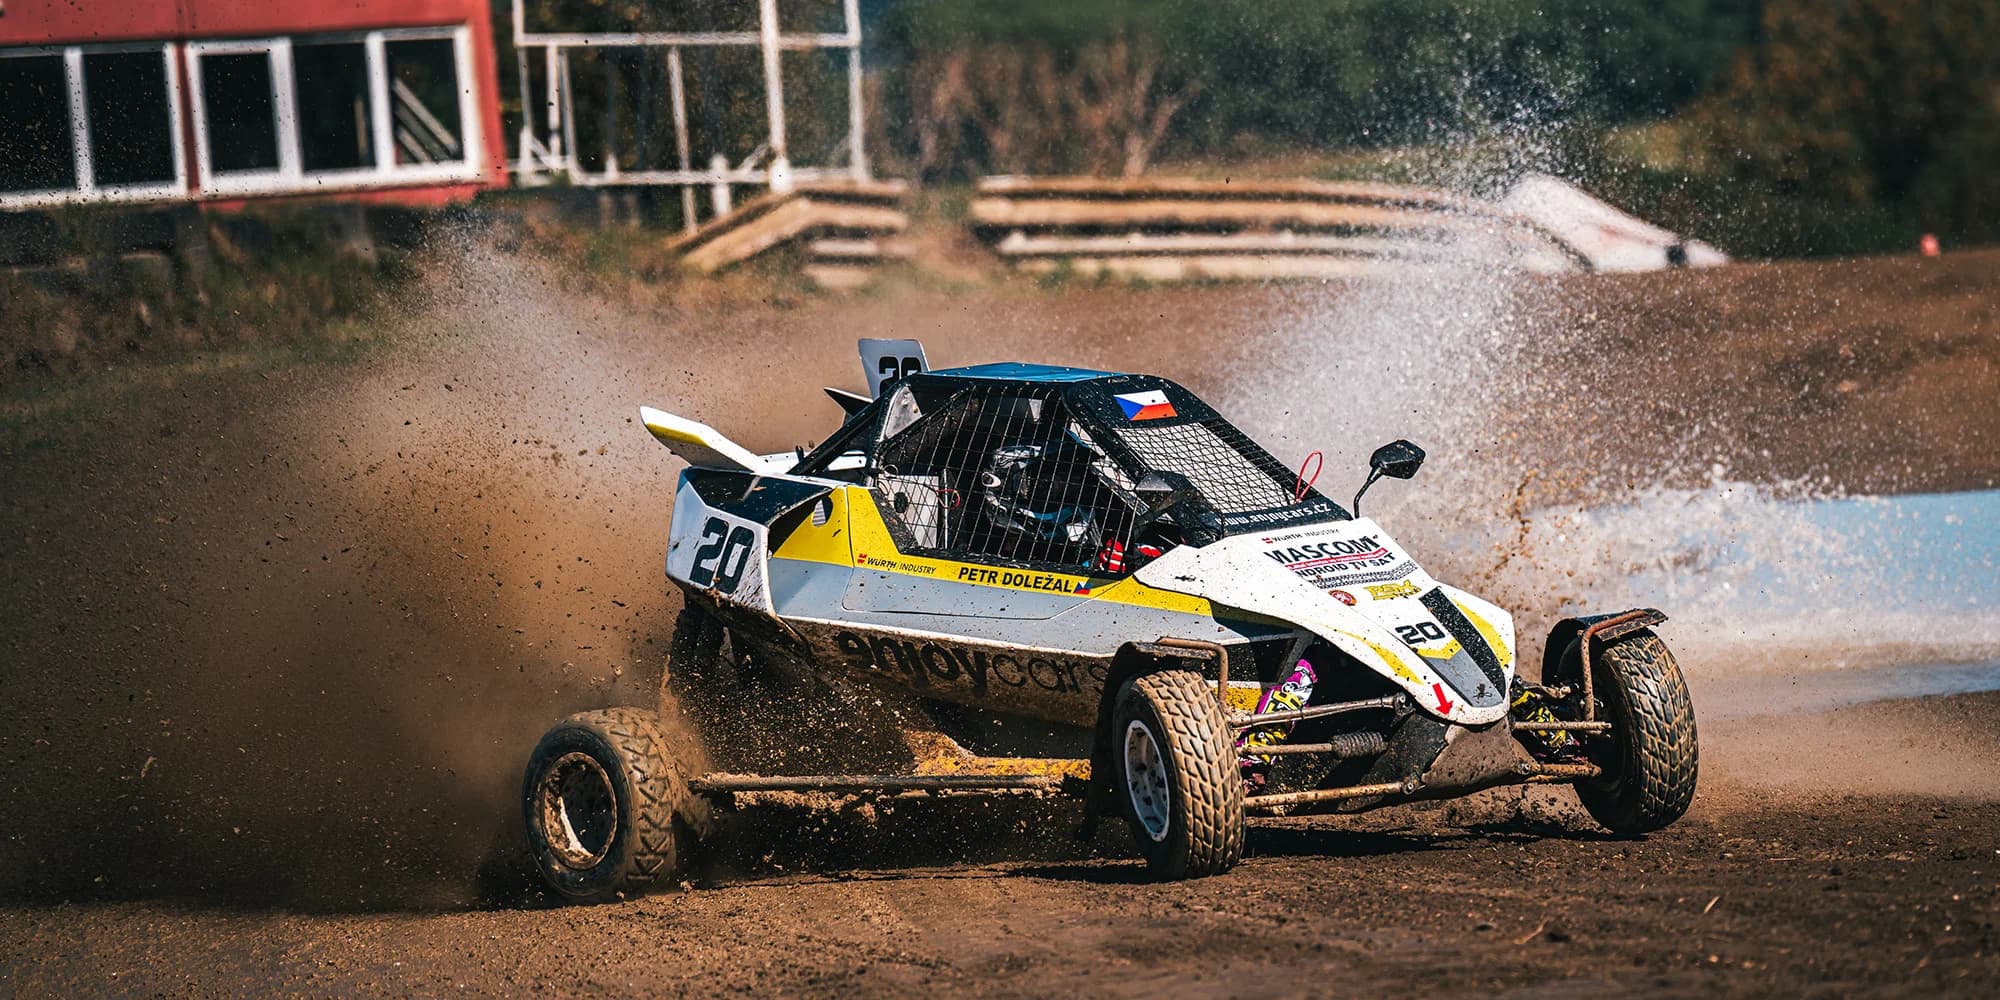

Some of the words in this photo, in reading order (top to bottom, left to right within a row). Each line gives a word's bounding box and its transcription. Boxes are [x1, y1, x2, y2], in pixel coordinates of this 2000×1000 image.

[689, 516, 754, 594] 20
[1294, 562, 1350, 577] NDROID
[1349, 560, 1368, 571] TV
[1371, 552, 1397, 567] SAT
[899, 562, 937, 575] INDUSTRY
[958, 567, 999, 585] PETR
[1001, 575, 1073, 593] DOLEŽAL
[1395, 621, 1446, 644] 20
